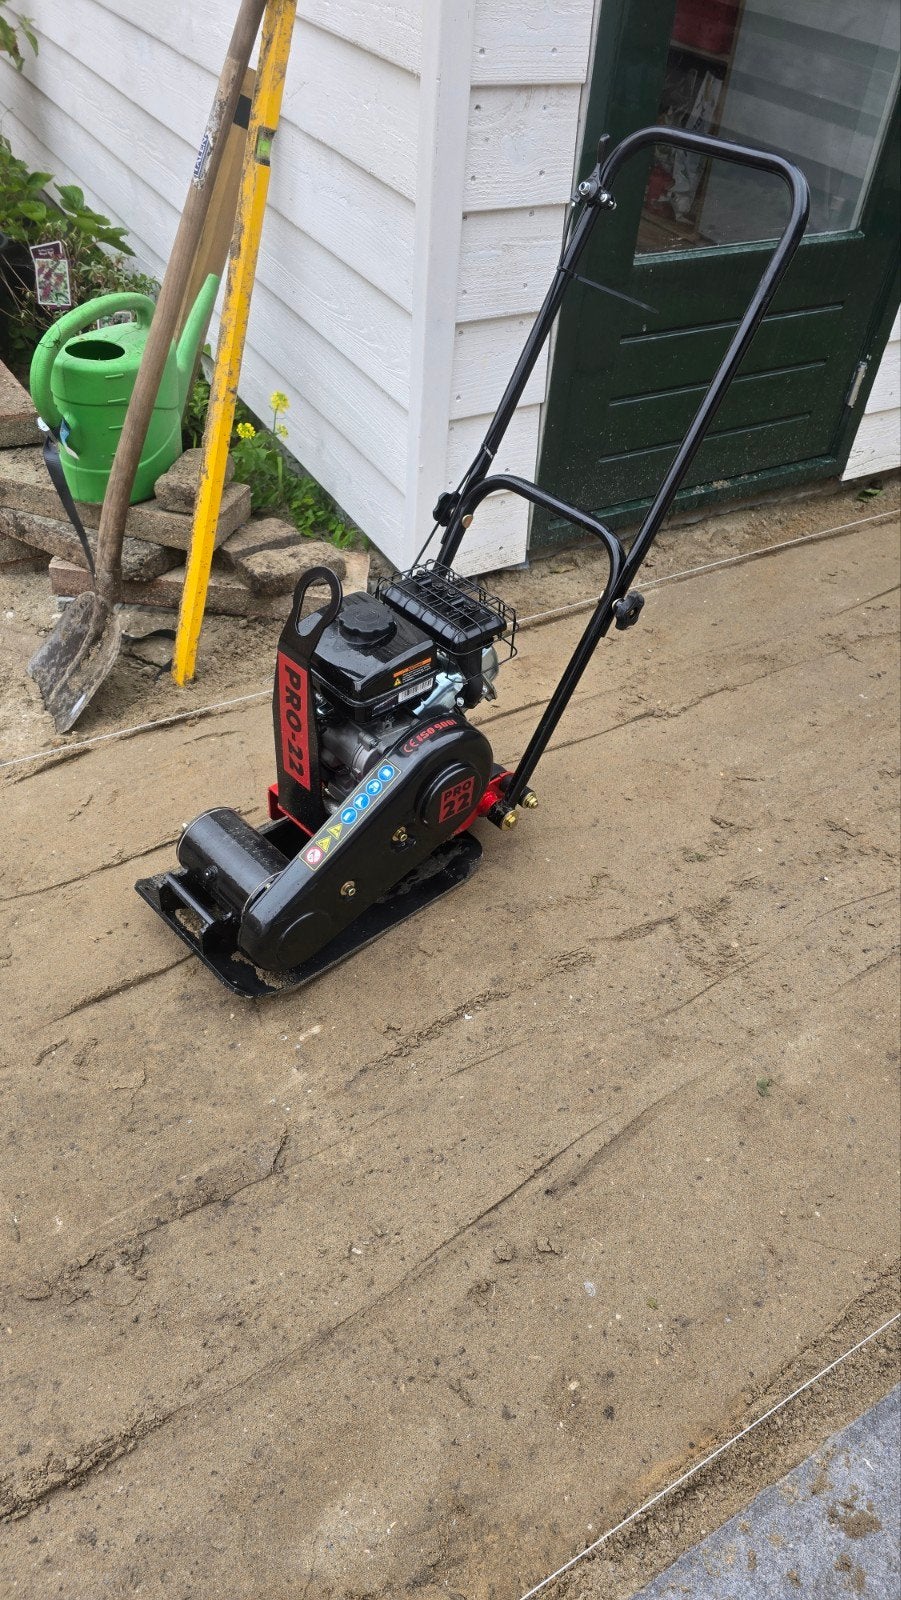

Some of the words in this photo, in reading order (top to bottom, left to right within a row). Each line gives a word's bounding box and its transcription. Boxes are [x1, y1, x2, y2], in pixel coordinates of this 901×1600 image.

[285, 664, 305, 777] PRO-22
[416, 727, 435, 742] ISO
[434, 720, 458, 730] 9001
[444, 780, 471, 800] PRO
[443, 793, 470, 820] 22
